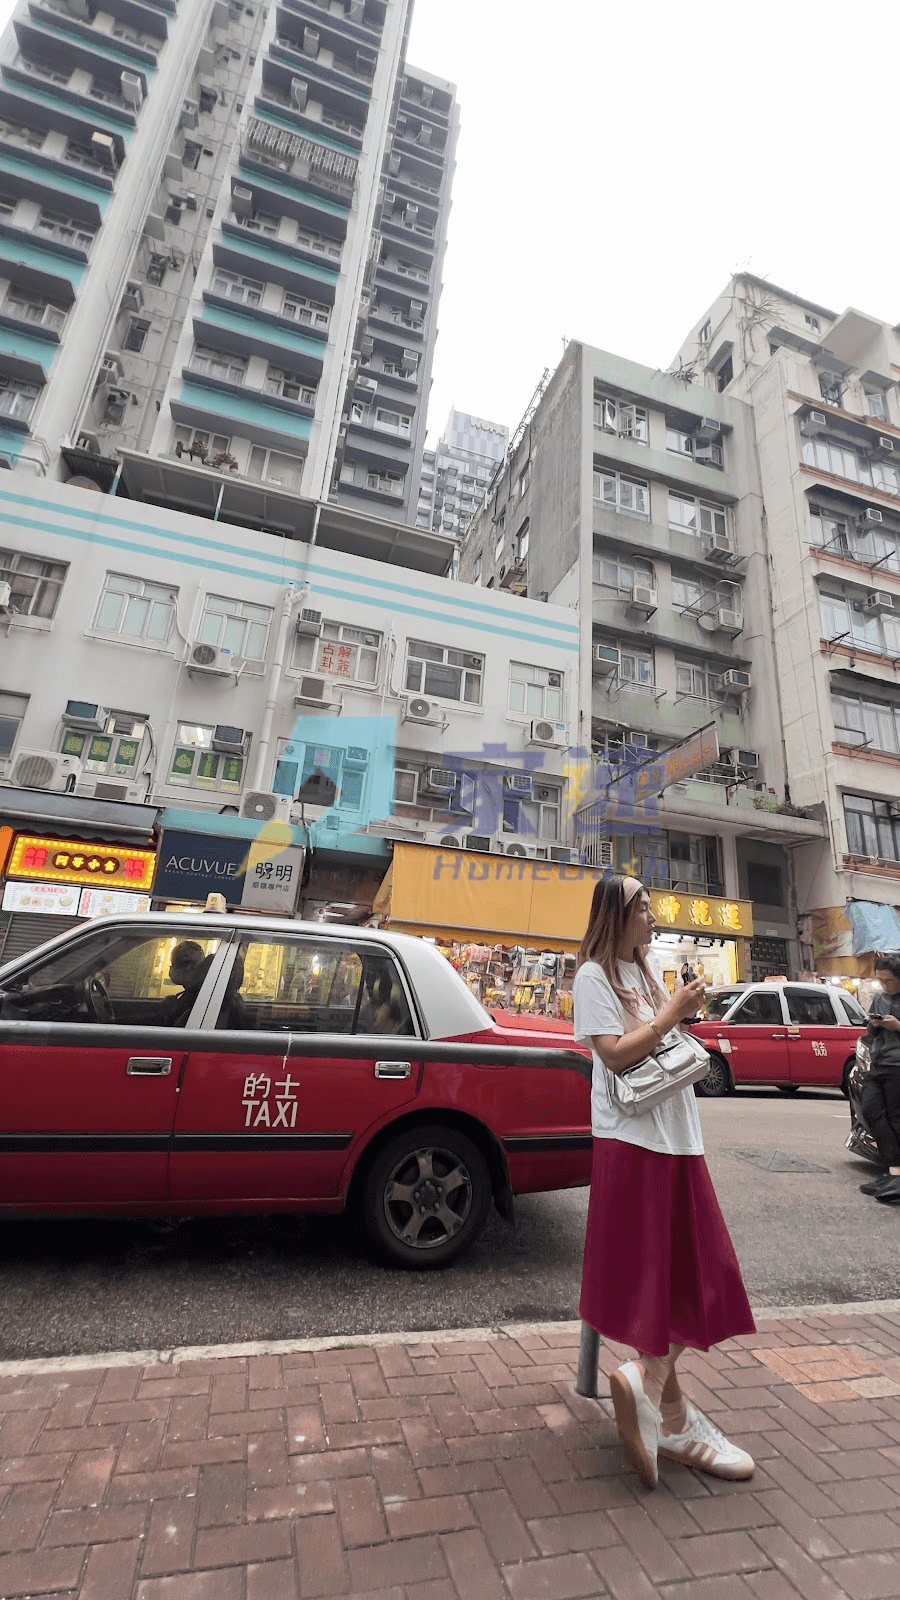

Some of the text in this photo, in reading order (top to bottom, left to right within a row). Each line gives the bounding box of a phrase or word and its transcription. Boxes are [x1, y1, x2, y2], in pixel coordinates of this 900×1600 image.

[166, 855, 237, 876] ACUVUE
[813, 1048, 828, 1057] TAXI
[243, 1072, 300, 1099] 的士
[241, 1100, 298, 1127] TAXI
